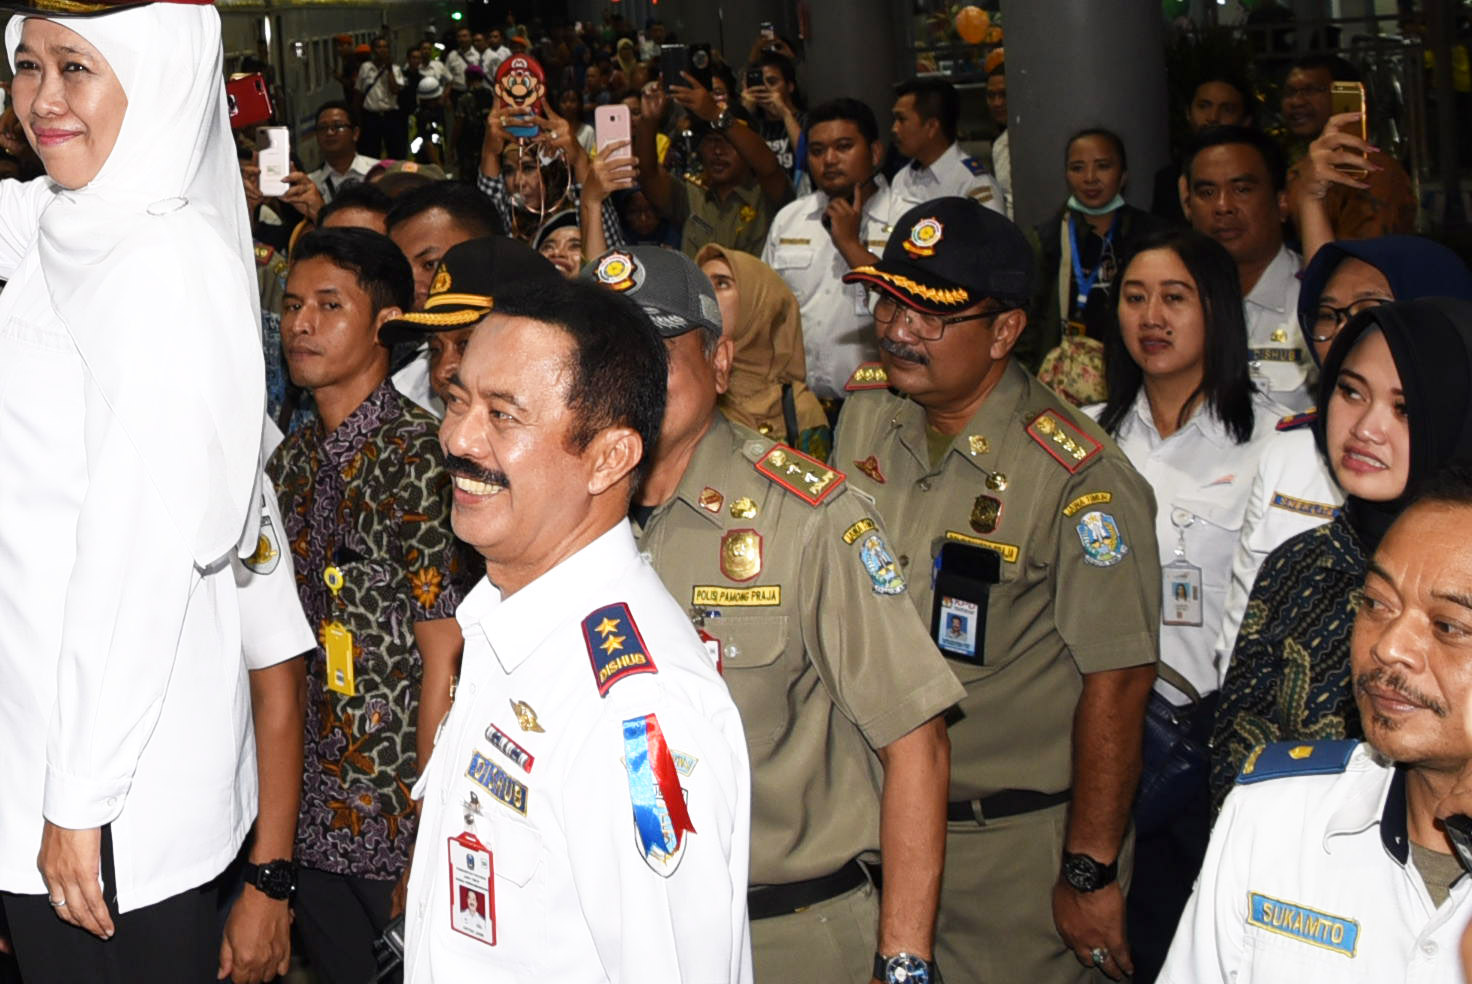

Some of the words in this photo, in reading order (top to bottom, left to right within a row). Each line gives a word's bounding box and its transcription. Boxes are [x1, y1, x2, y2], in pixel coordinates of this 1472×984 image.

[599, 652, 647, 684] DISHUB
[473, 757, 523, 809] DISHUB
[1262, 902, 1345, 945] SUKAMTO
